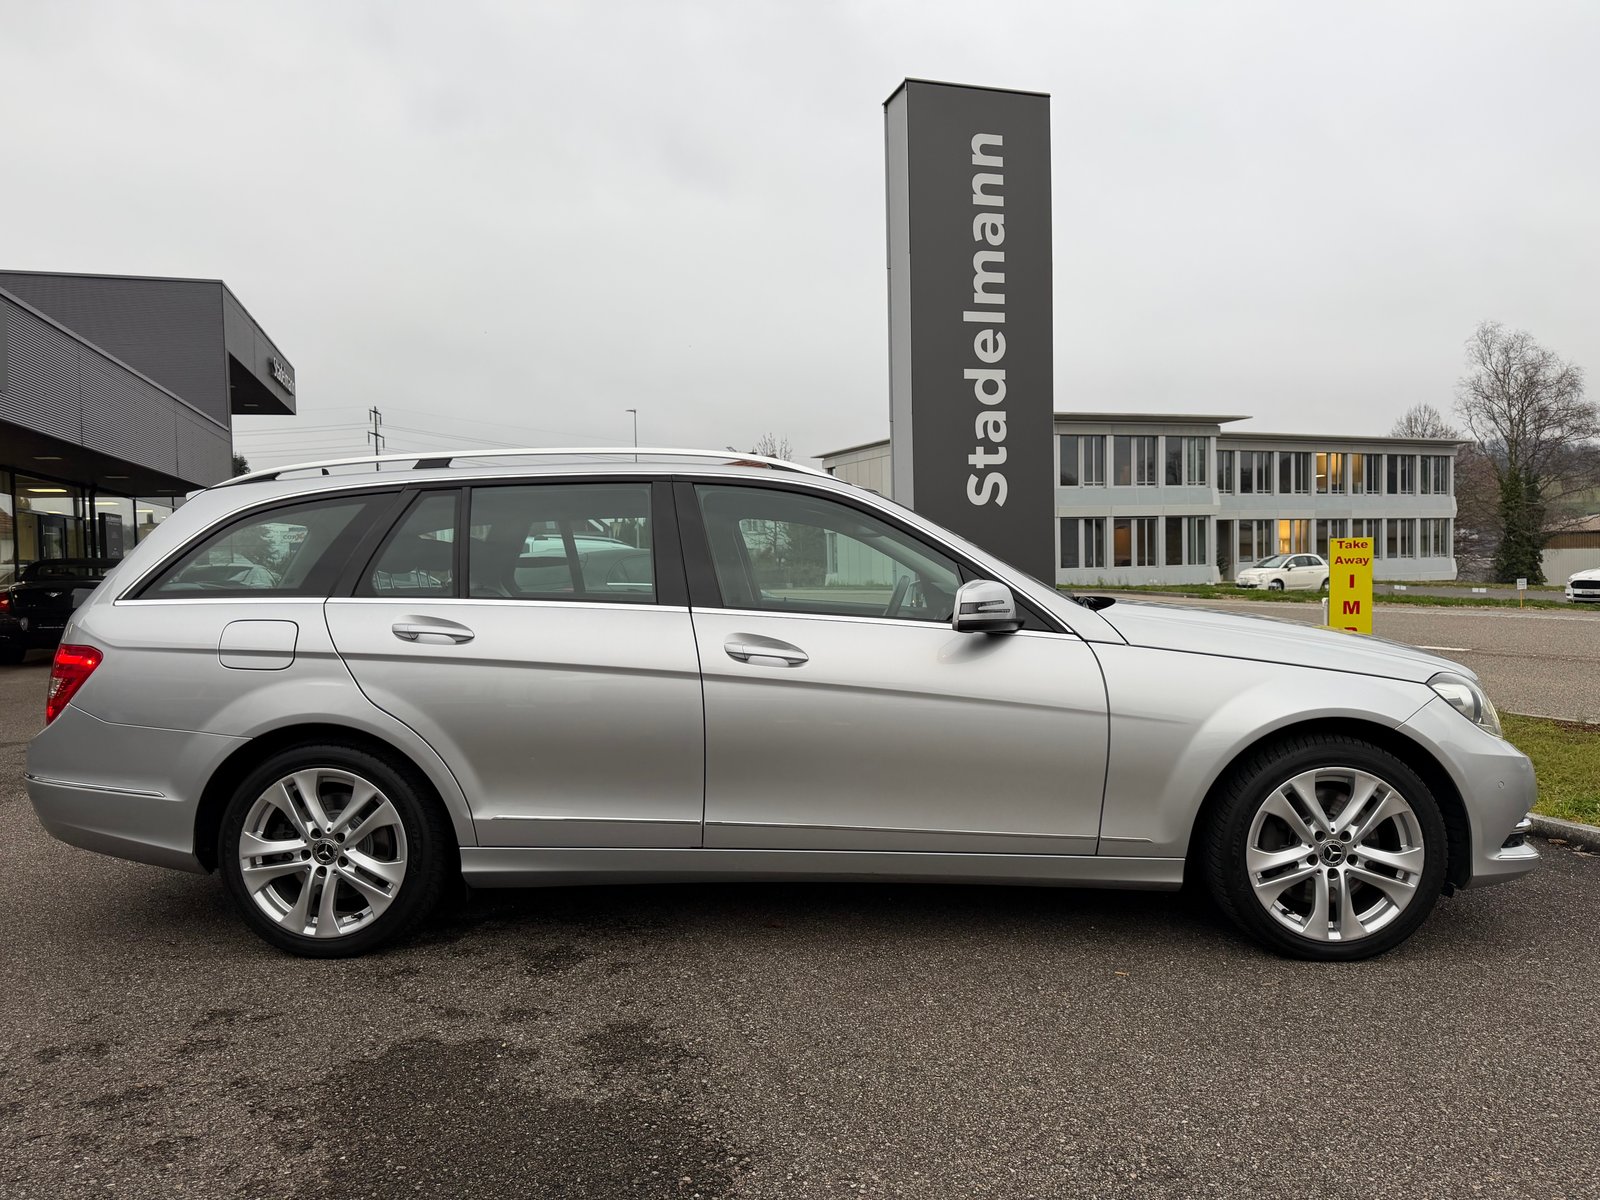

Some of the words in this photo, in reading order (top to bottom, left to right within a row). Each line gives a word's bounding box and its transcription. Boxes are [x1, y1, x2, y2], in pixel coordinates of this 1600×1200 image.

[963, 133, 1008, 507] Stadelmann
[1335, 556, 1370, 567] Away
[1336, 540, 1369, 549] Take
[1343, 574, 1360, 632] IM
